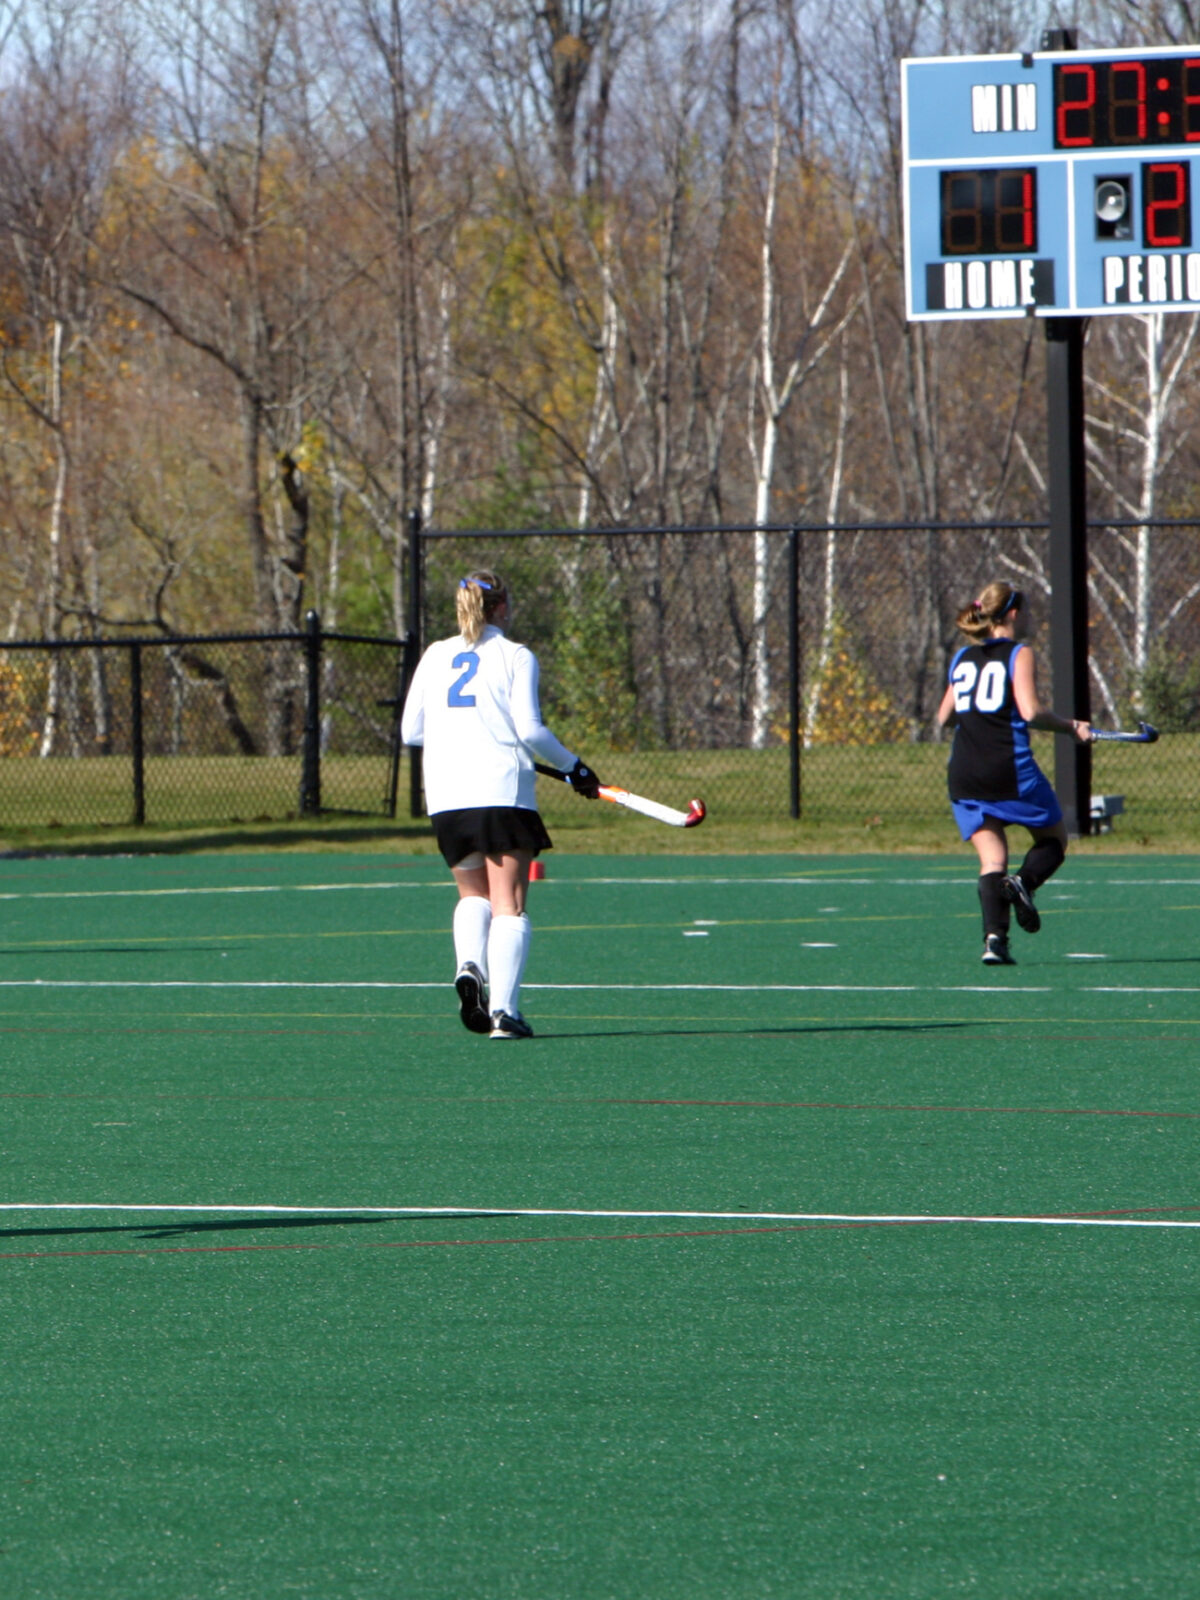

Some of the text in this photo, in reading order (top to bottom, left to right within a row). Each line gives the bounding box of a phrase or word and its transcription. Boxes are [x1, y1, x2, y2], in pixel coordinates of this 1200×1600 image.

[972, 84, 1036, 132] MIN
[1022, 173, 1032, 246] 1
[1146, 164, 1185, 246] 2
[944, 260, 1035, 309] HOME
[447, 651, 480, 708] 2
[952, 661, 1006, 713] 20
